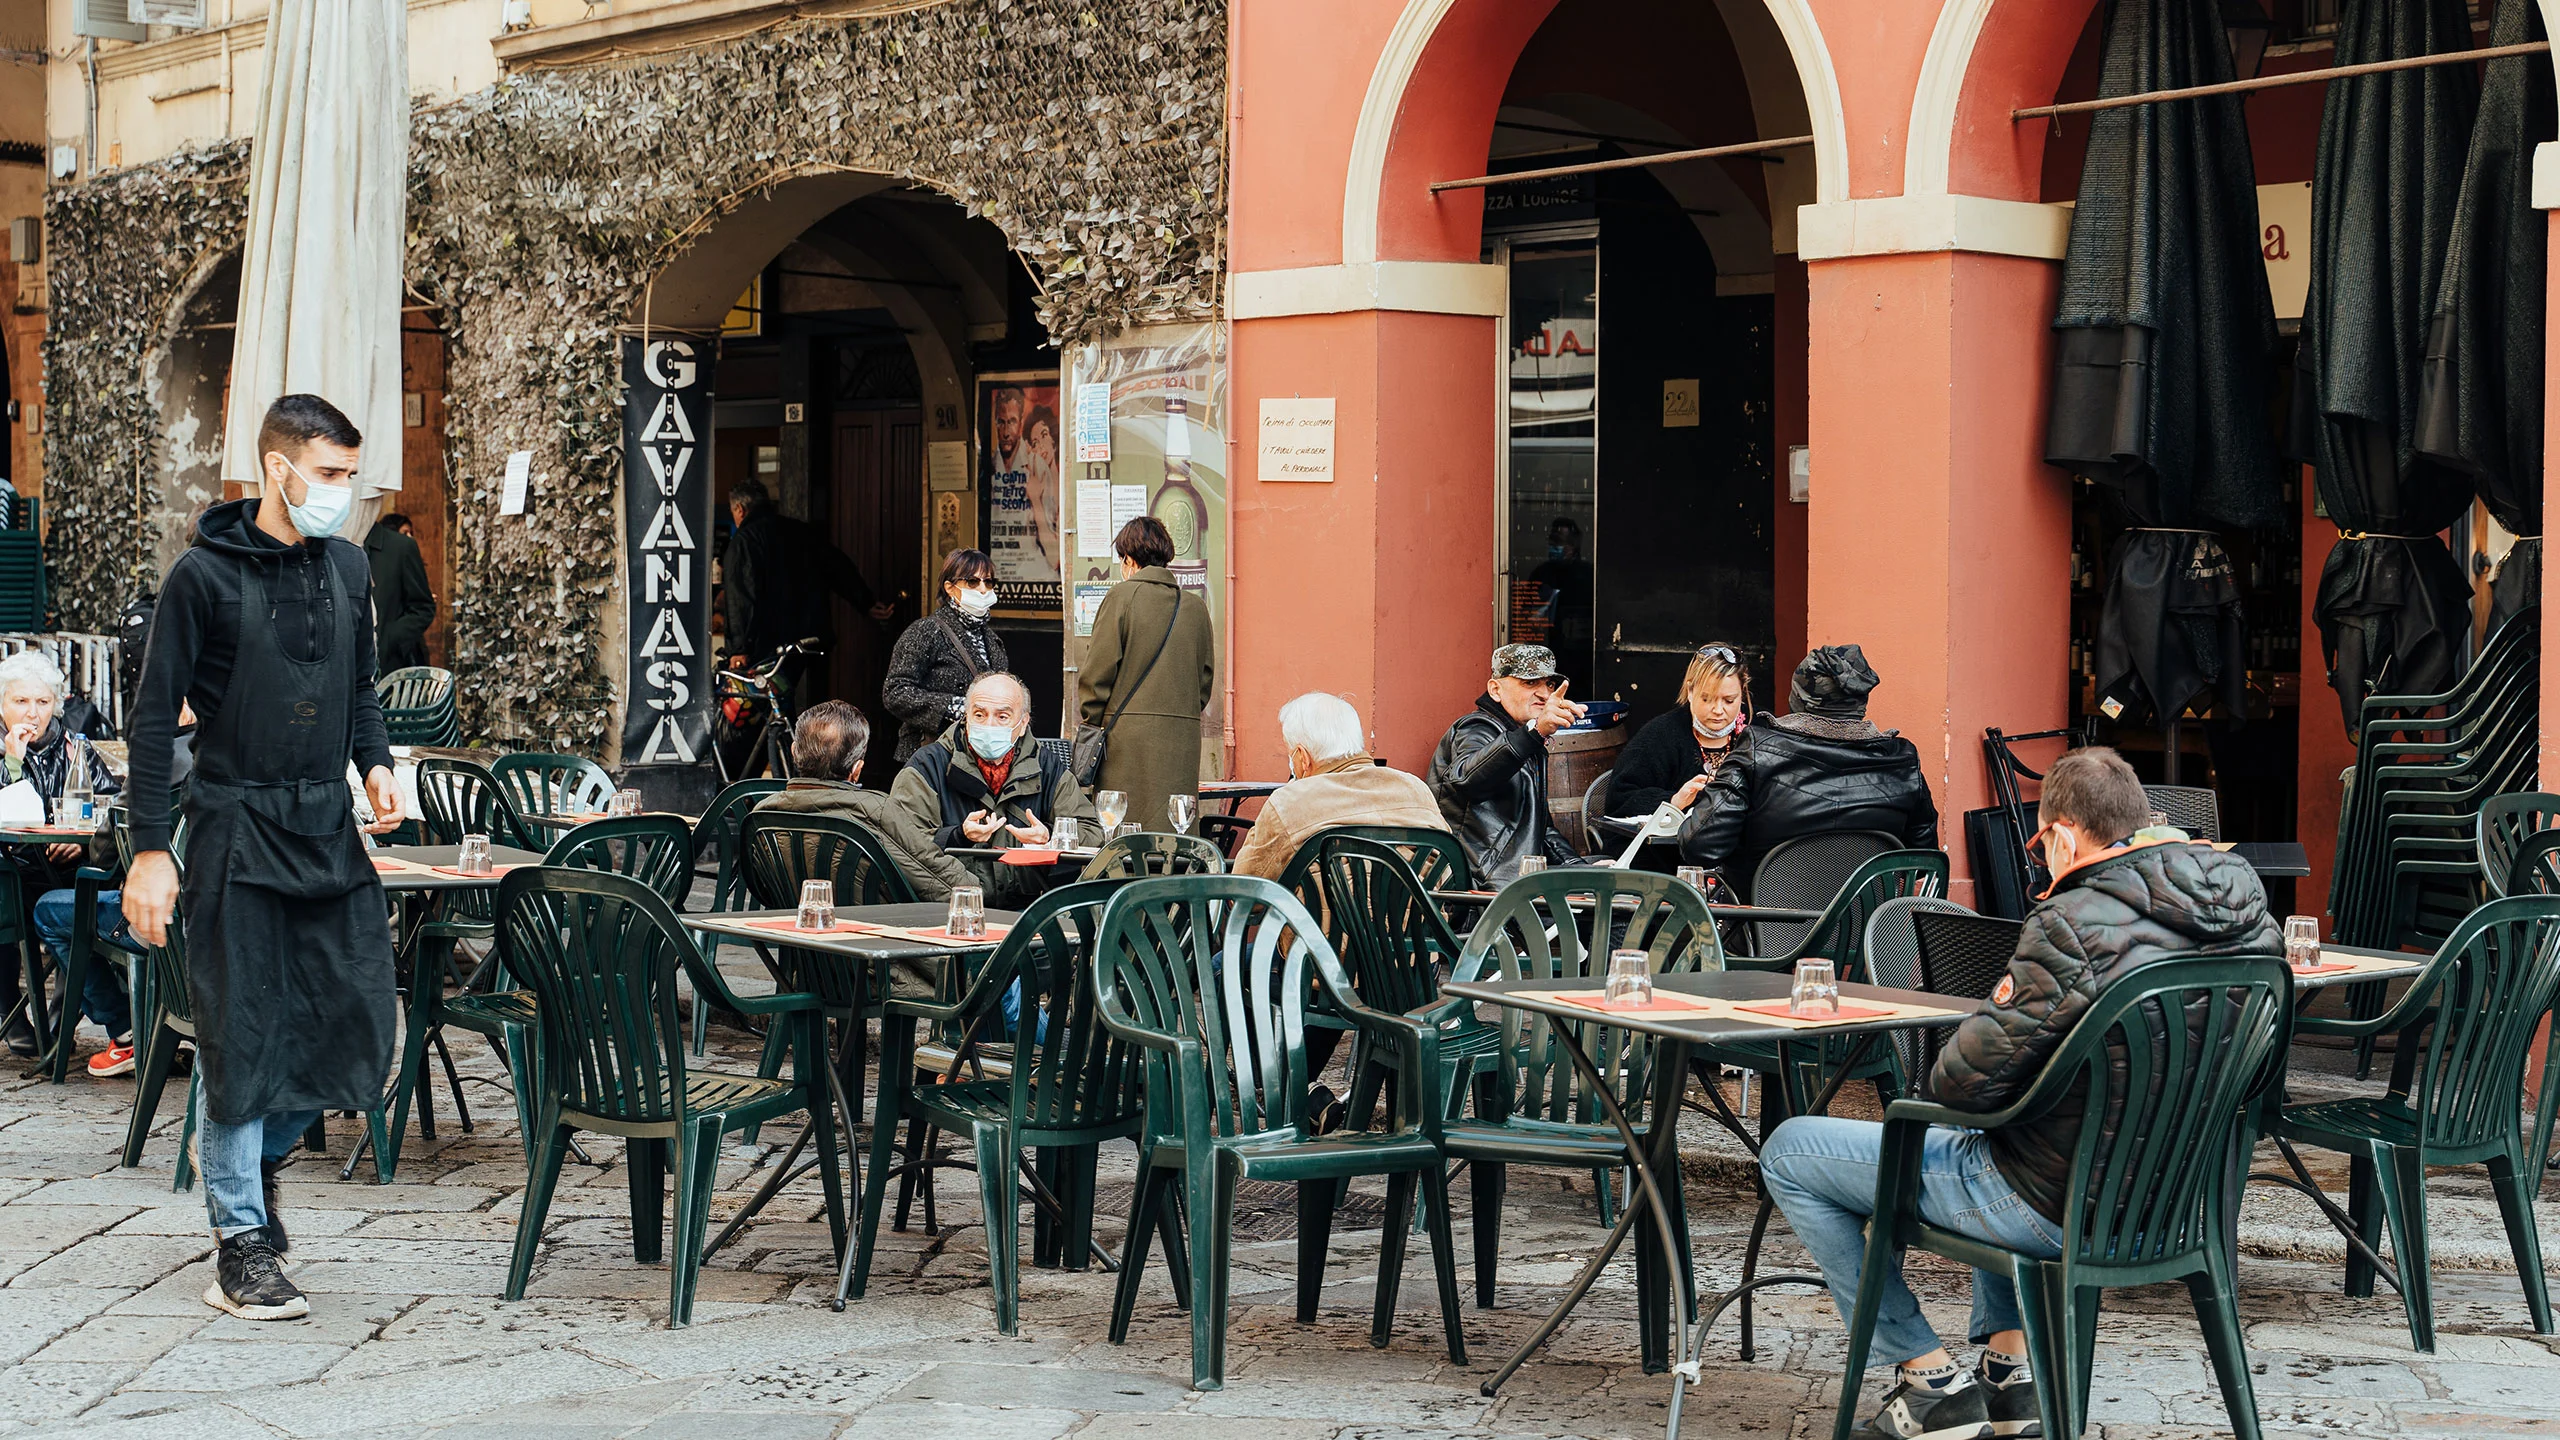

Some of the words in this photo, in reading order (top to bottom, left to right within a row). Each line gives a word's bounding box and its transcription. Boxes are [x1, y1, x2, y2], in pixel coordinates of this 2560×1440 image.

[1487, 195, 1514, 211] ZZA
[665, 340, 674, 432] MOVIDA
[1002, 470, 1027, 484] GATTA
[664, 444, 673, 535] HOUSE
[1002, 485, 1026, 498] TETTO
[1001, 498, 1032, 511] SCOTTA
[639, 340, 698, 763] GAVANASA
[1175, 573, 1206, 586] TREUSE
[664, 550, 673, 643] PARMA
[663, 662, 672, 726] CITY
[1905, 1365, 1954, 1377] ARRERA
